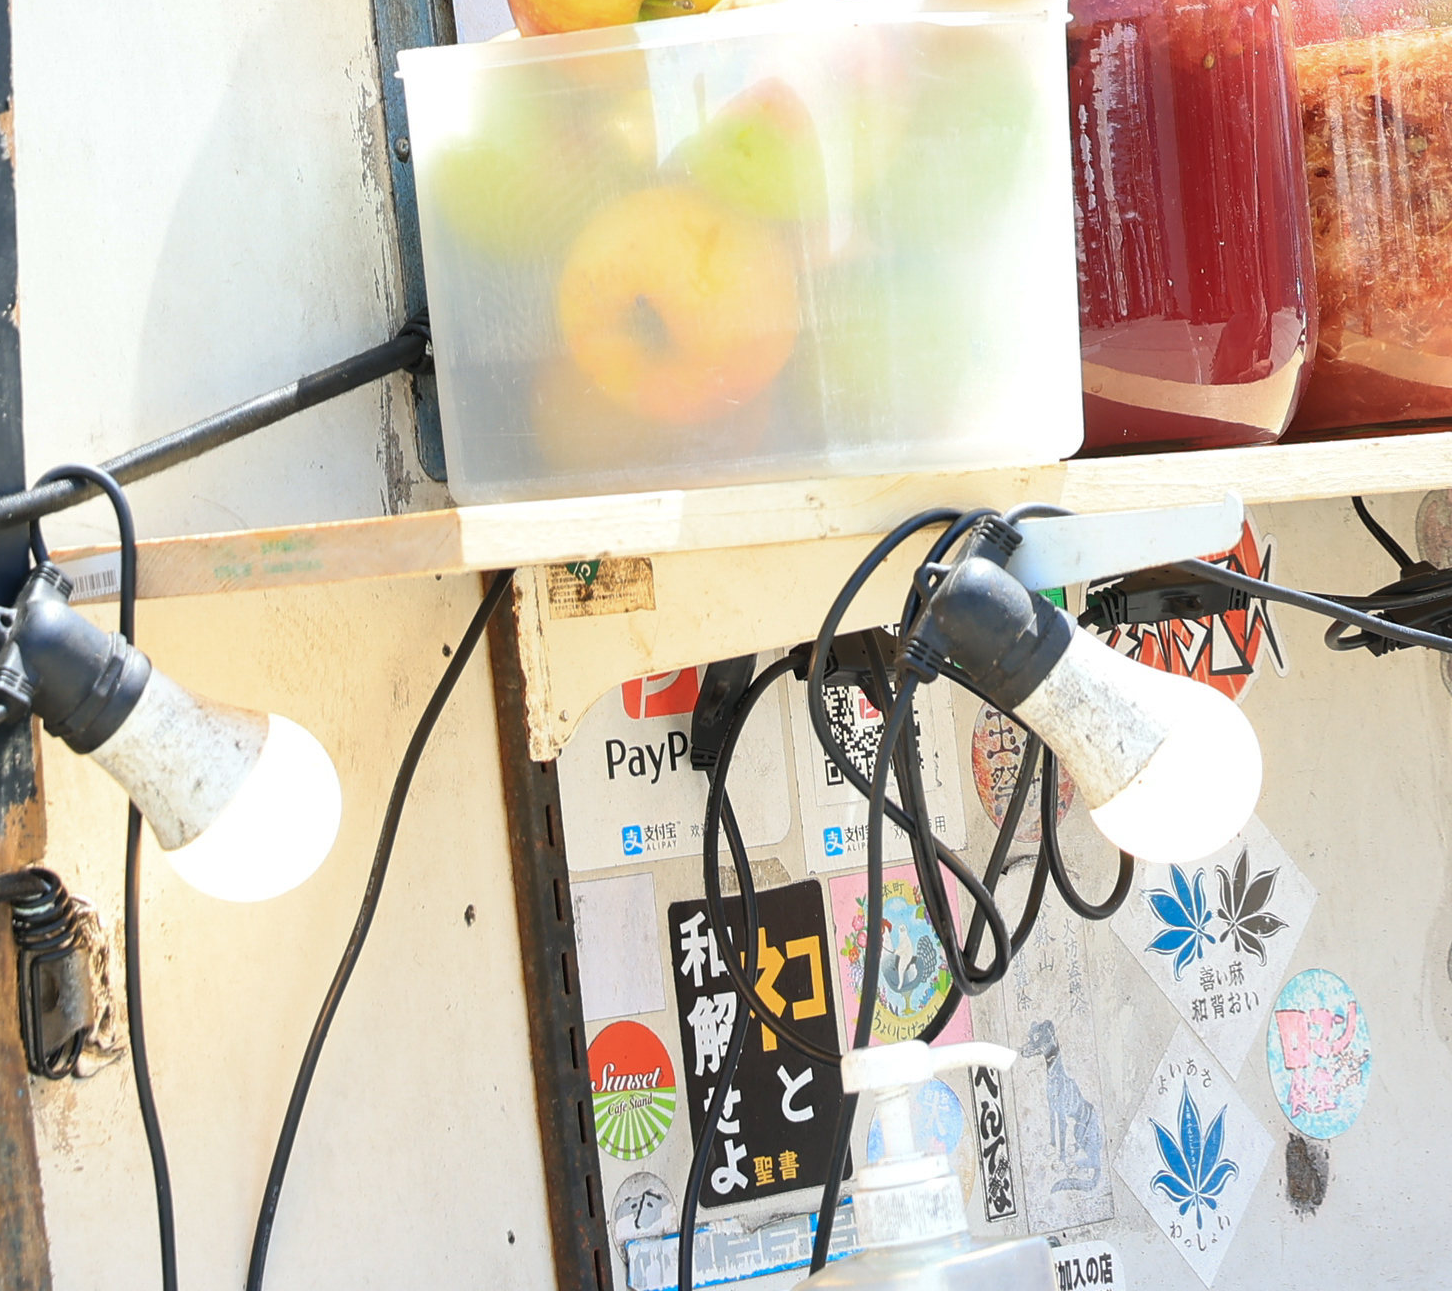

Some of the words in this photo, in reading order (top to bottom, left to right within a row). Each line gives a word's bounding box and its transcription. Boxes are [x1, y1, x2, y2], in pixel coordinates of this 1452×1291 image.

[605, 730, 690, 785] PayP
[847, 842, 868, 853] ALIP
[590, 1062, 662, 1093] Sunset
[629, 1092, 653, 1110] Stand
[753, 1150, 801, 1187] 聖書
[1055, 1252, 1114, 1291] 加入の店
